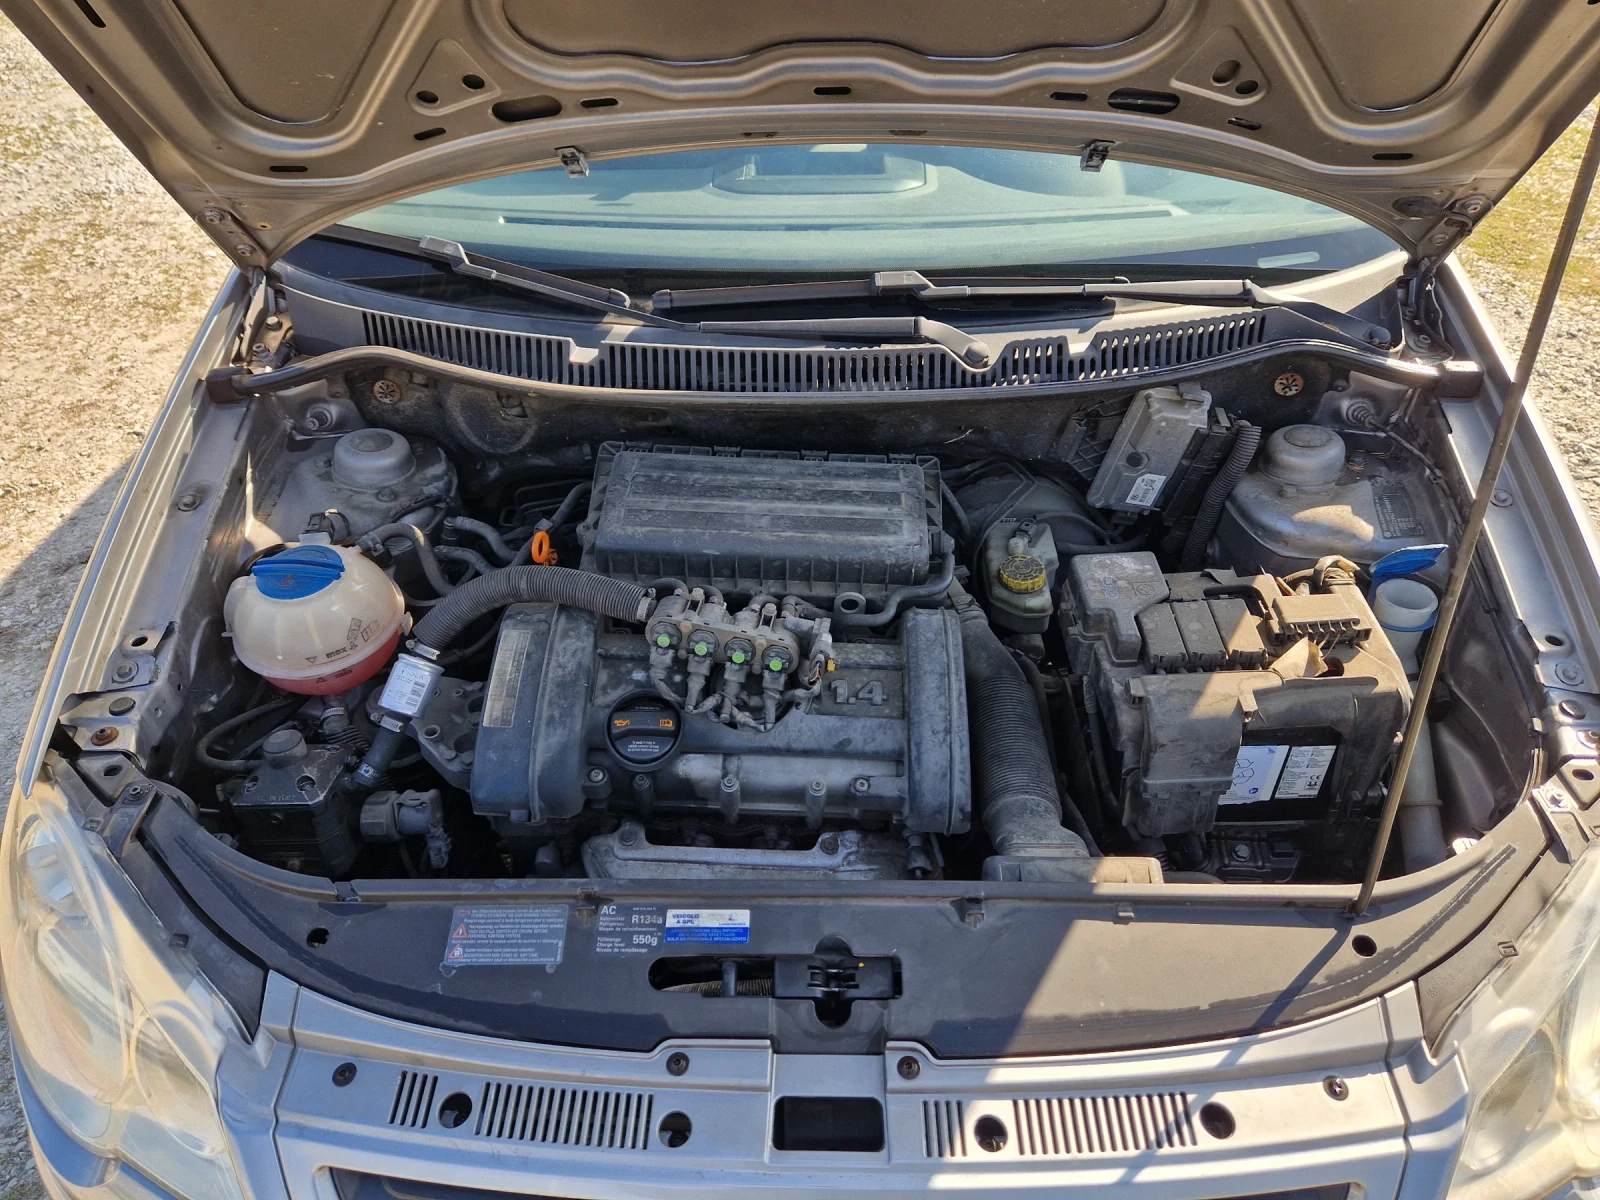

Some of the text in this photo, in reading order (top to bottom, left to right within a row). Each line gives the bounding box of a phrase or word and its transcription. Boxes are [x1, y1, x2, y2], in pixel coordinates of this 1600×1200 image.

[326, 646, 347, 658] max
[829, 680, 888, 705] 1.4
[600, 906, 616, 915] AC
[632, 914, 662, 924] R134a
[632, 935, 658, 946] 550g
